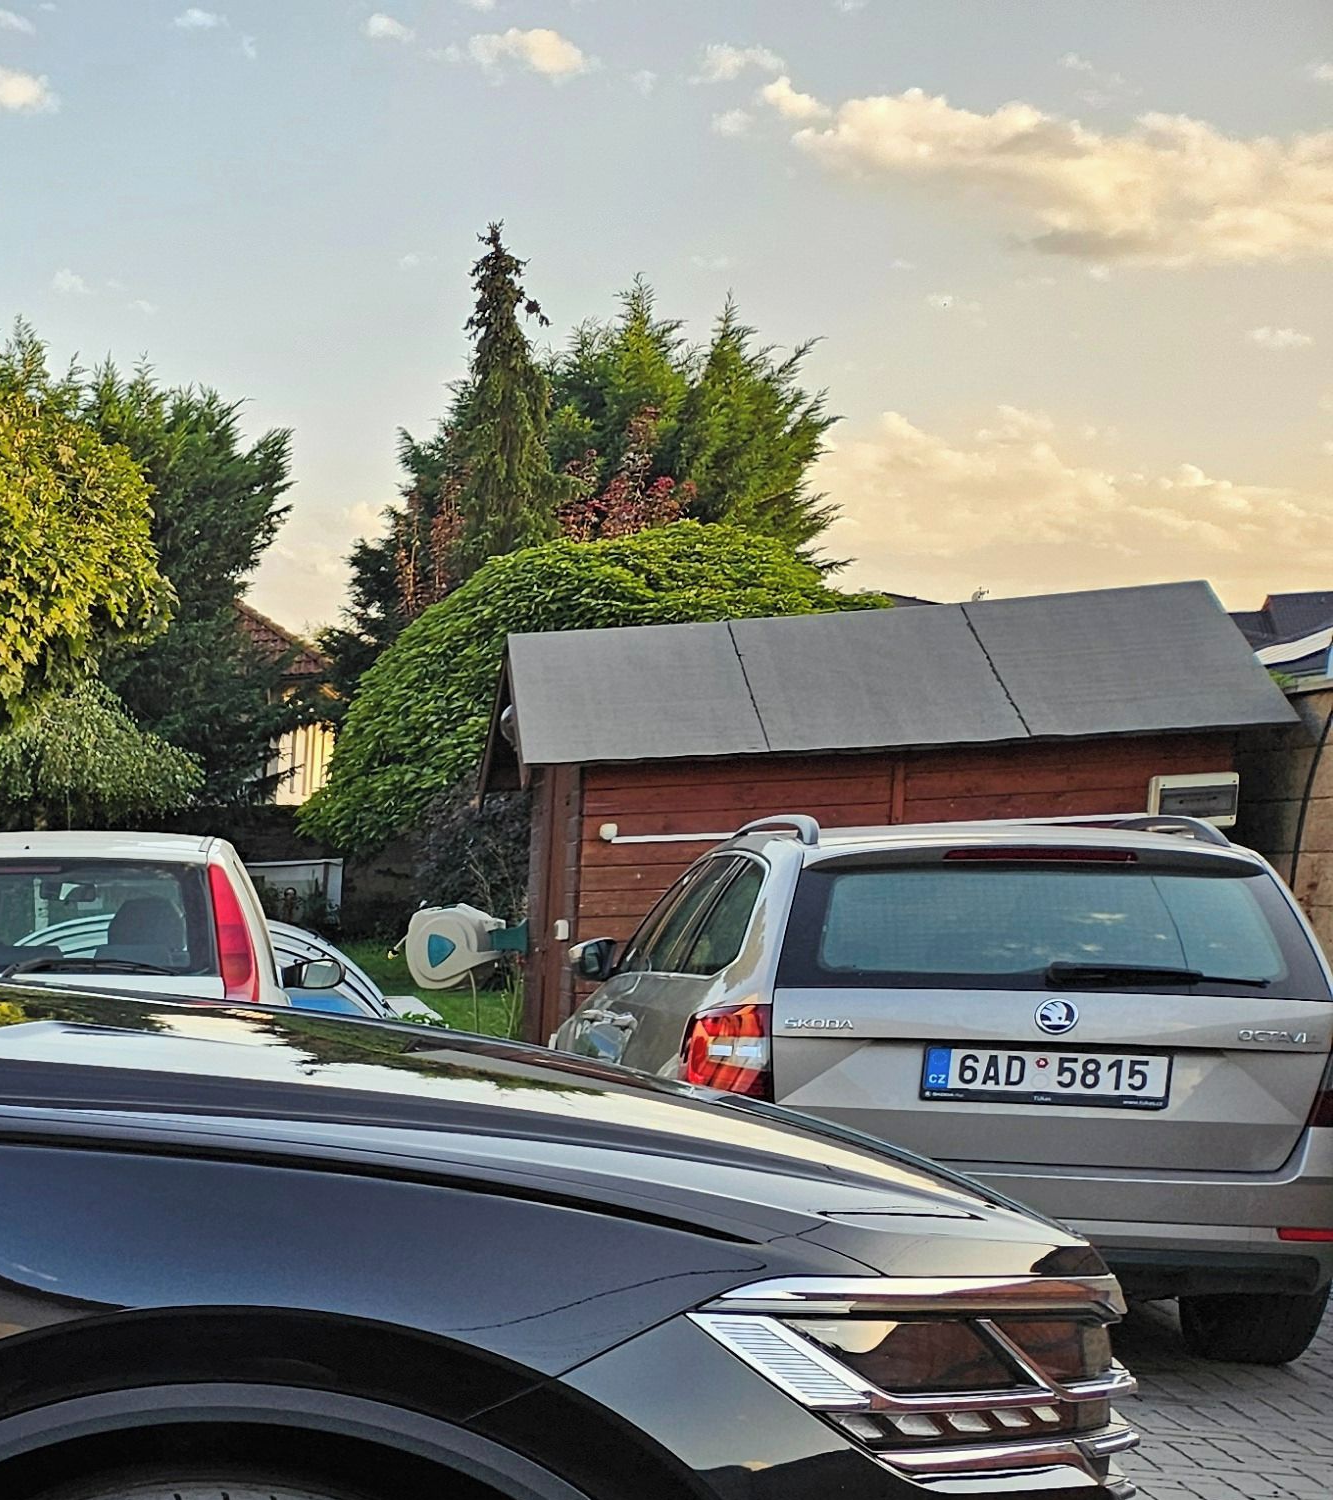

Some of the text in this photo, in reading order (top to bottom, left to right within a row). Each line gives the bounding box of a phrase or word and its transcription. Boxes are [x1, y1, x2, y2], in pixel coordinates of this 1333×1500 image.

[928, 1073, 946, 1084] CZ
[958, 1053, 1149, 1091] 6AD 5815
